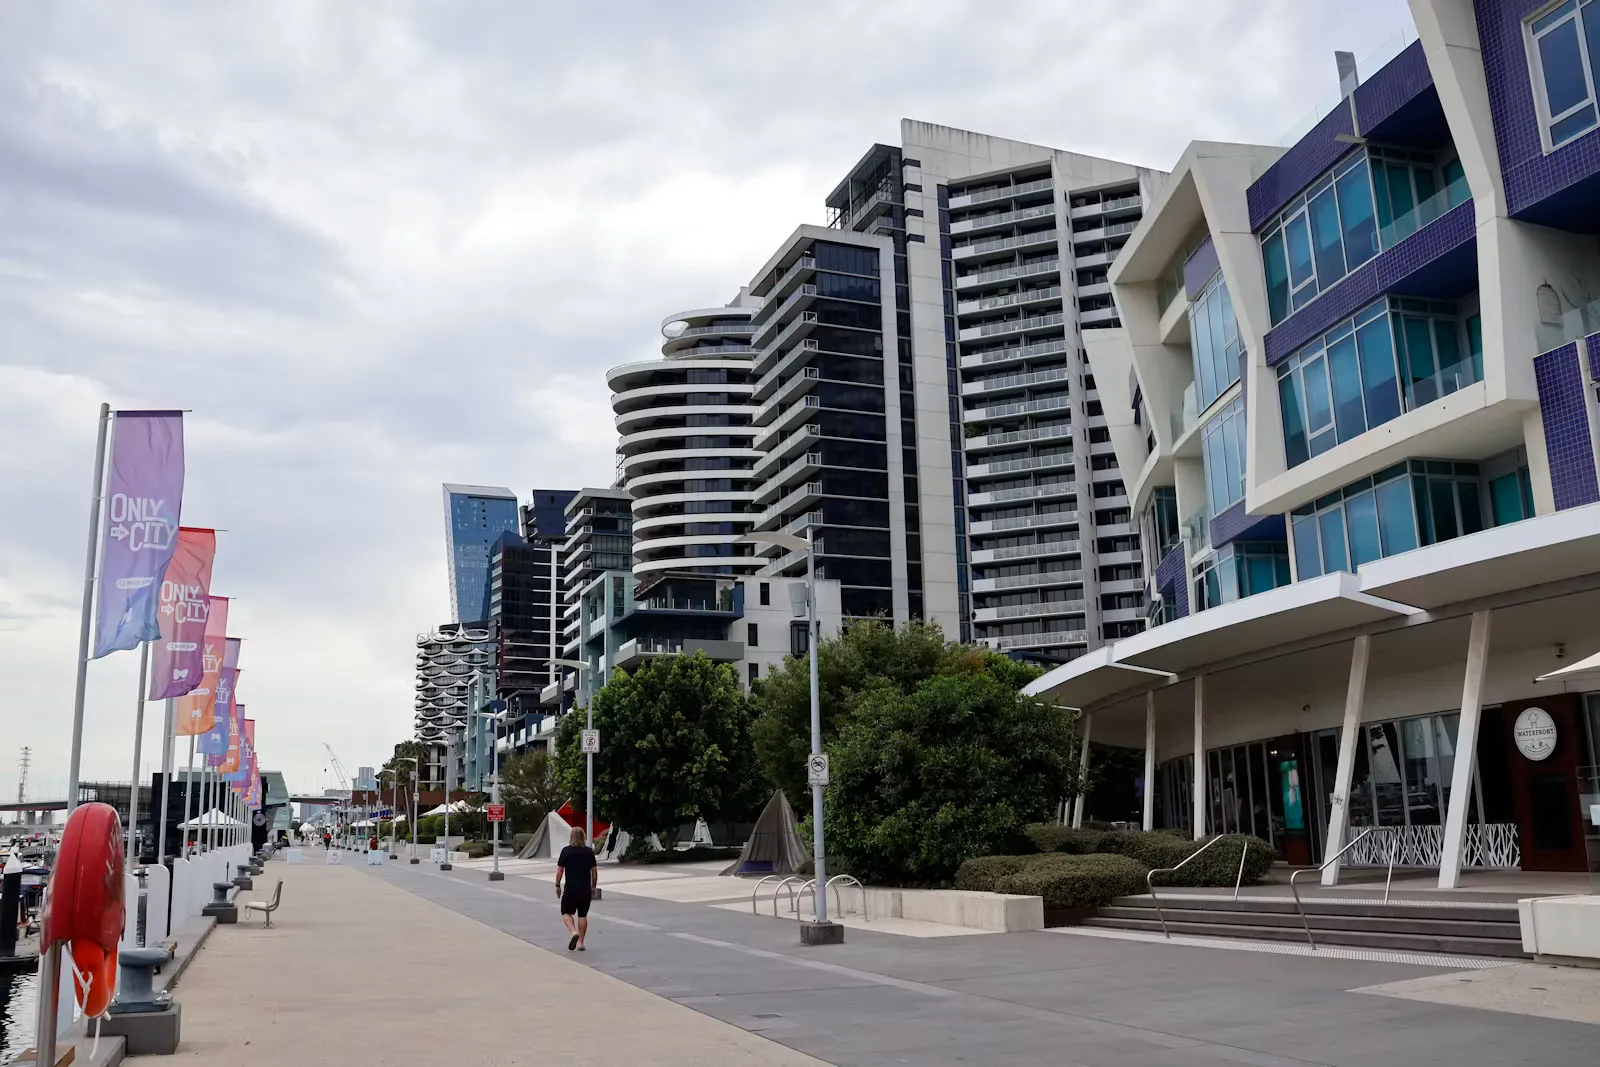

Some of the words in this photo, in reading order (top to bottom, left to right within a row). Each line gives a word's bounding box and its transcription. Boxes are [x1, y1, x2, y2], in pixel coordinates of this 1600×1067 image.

[110, 493, 168, 523] ONLY
[129, 522, 178, 552] CITY
[161, 580, 204, 603] ONLY
[175, 601, 210, 624] CITY
[203, 657, 222, 673] ITY
[1516, 729, 1553, 737] WATERFRONT
